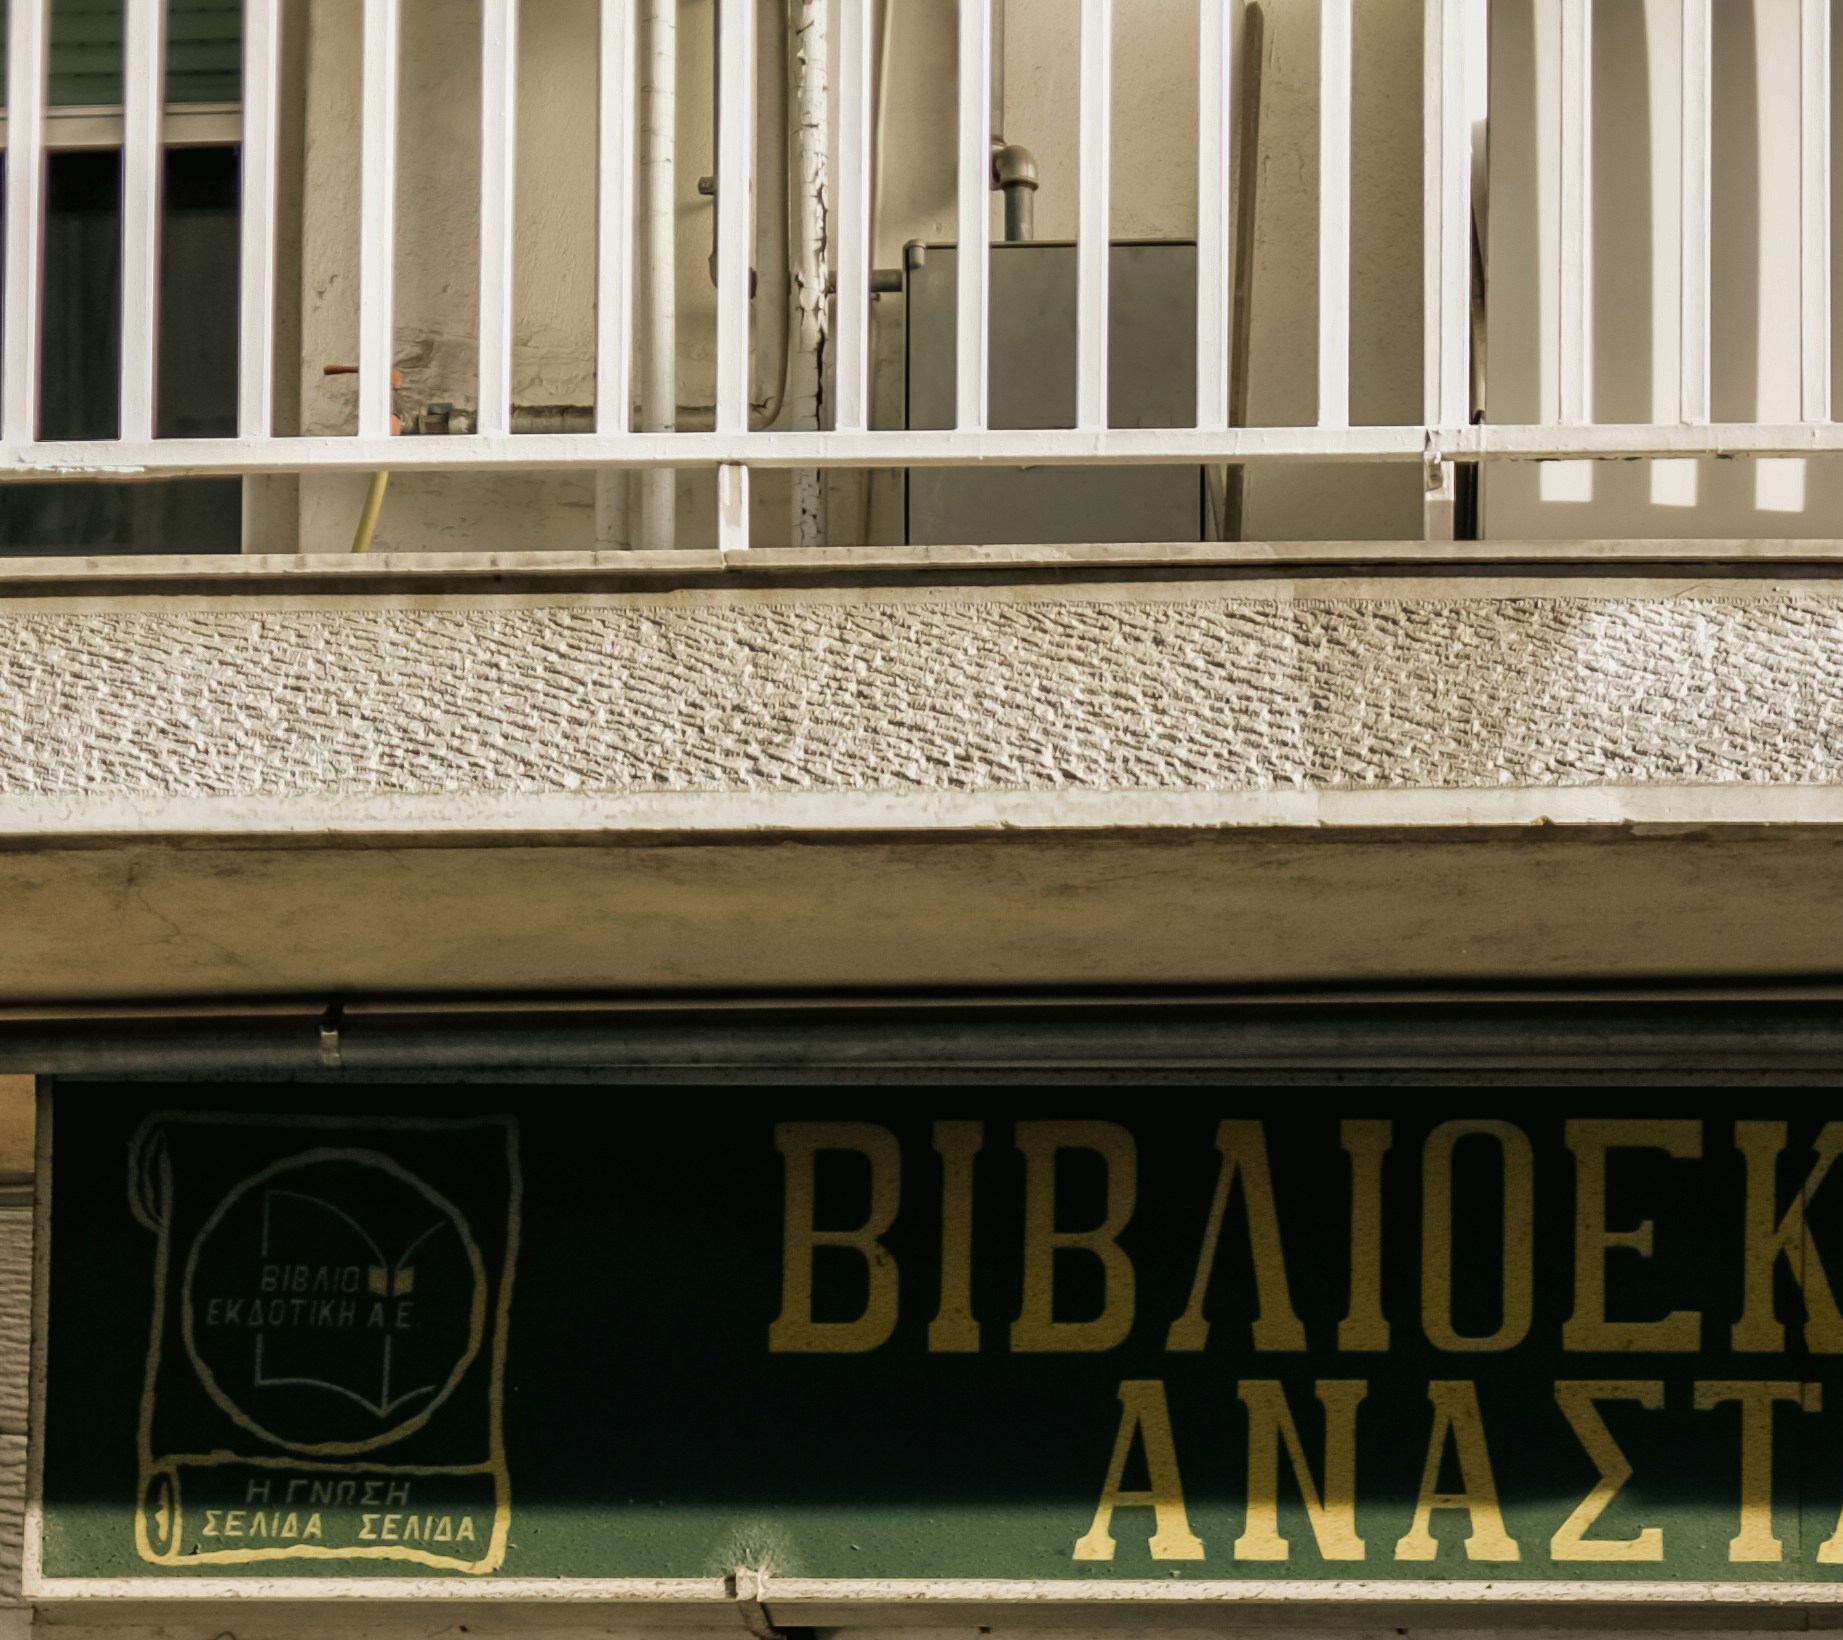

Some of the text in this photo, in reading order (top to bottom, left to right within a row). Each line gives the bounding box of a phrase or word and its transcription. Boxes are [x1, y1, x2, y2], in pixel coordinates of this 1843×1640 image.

[261, 1265, 360, 1293] ΒΙΒΛΙΟ
[206, 1298, 356, 1327] ΕΚΔΟΤΙΚΗ
[246, 1479, 411, 1506] Η ΓΝΩΣΗ
[201, 1510, 476, 1542] ΣΕΛΙΔΑ ΣΕΛΙΔΑ
